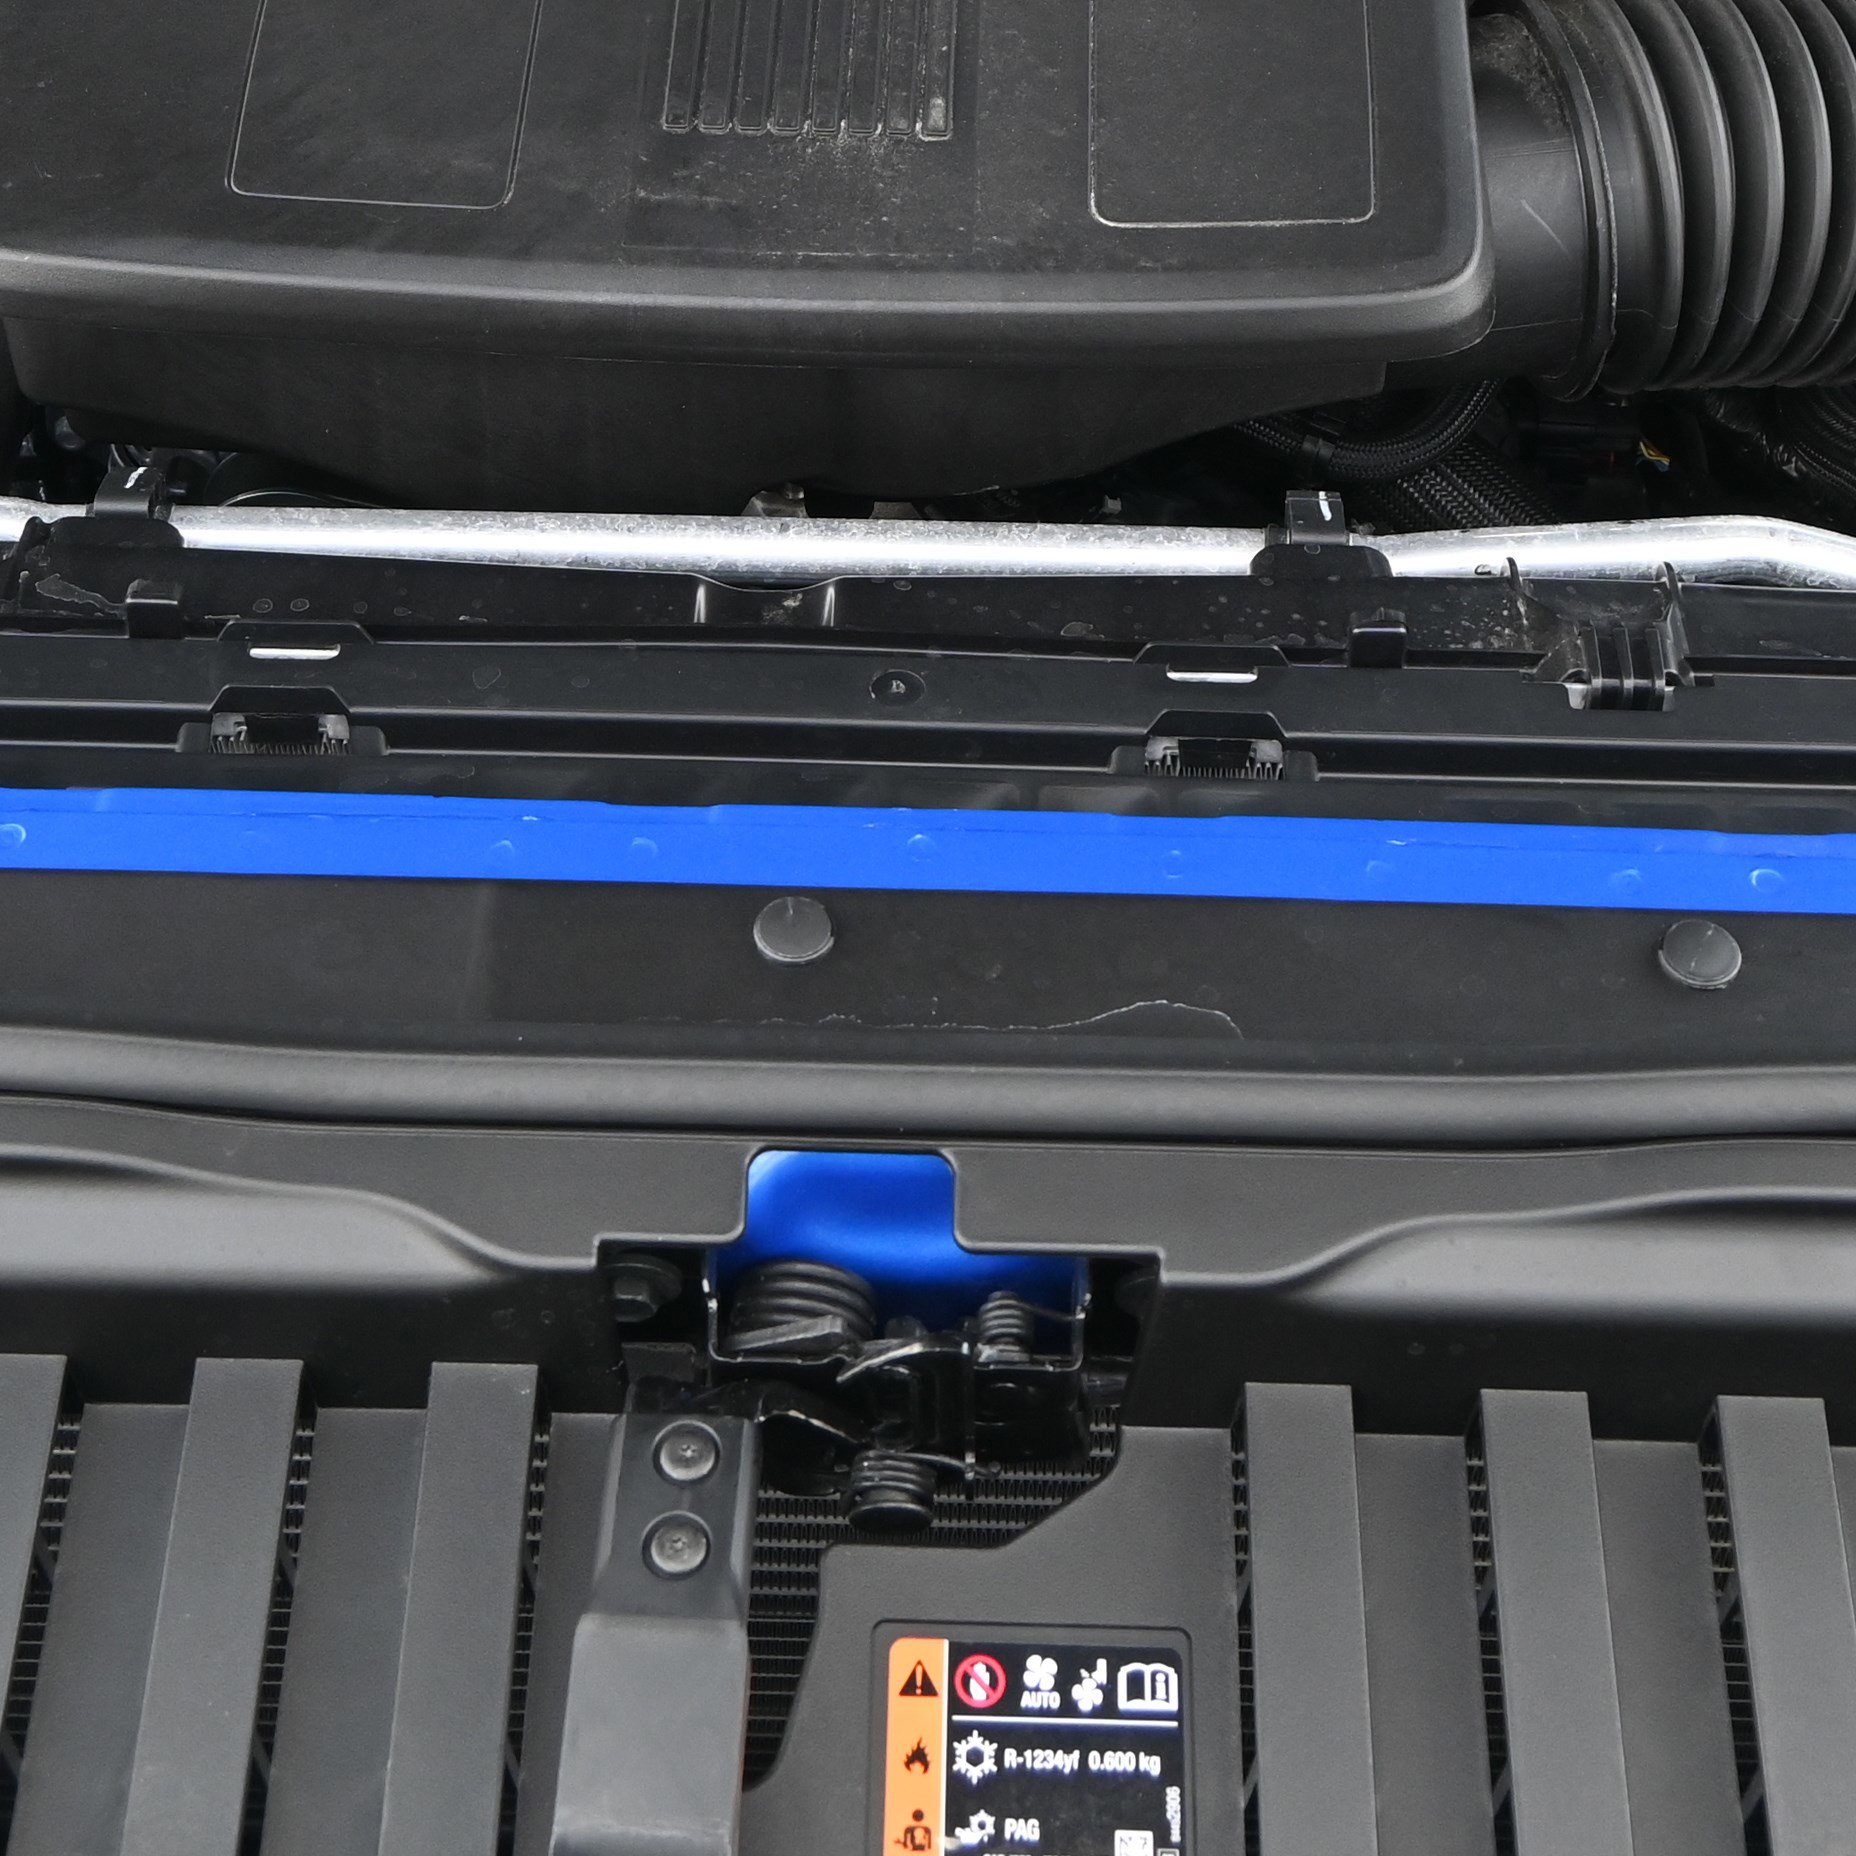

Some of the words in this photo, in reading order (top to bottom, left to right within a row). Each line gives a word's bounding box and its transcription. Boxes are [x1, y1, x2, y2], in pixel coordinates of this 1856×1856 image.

[1020, 1691, 1061, 1710] AUTO
[1003, 1747, 1081, 1775] R-1234yf
[1087, 1750, 1137, 1773] 0.600
[1139, 1751, 1162, 1777] kg
[1003, 1817, 1041, 1842] PAG
